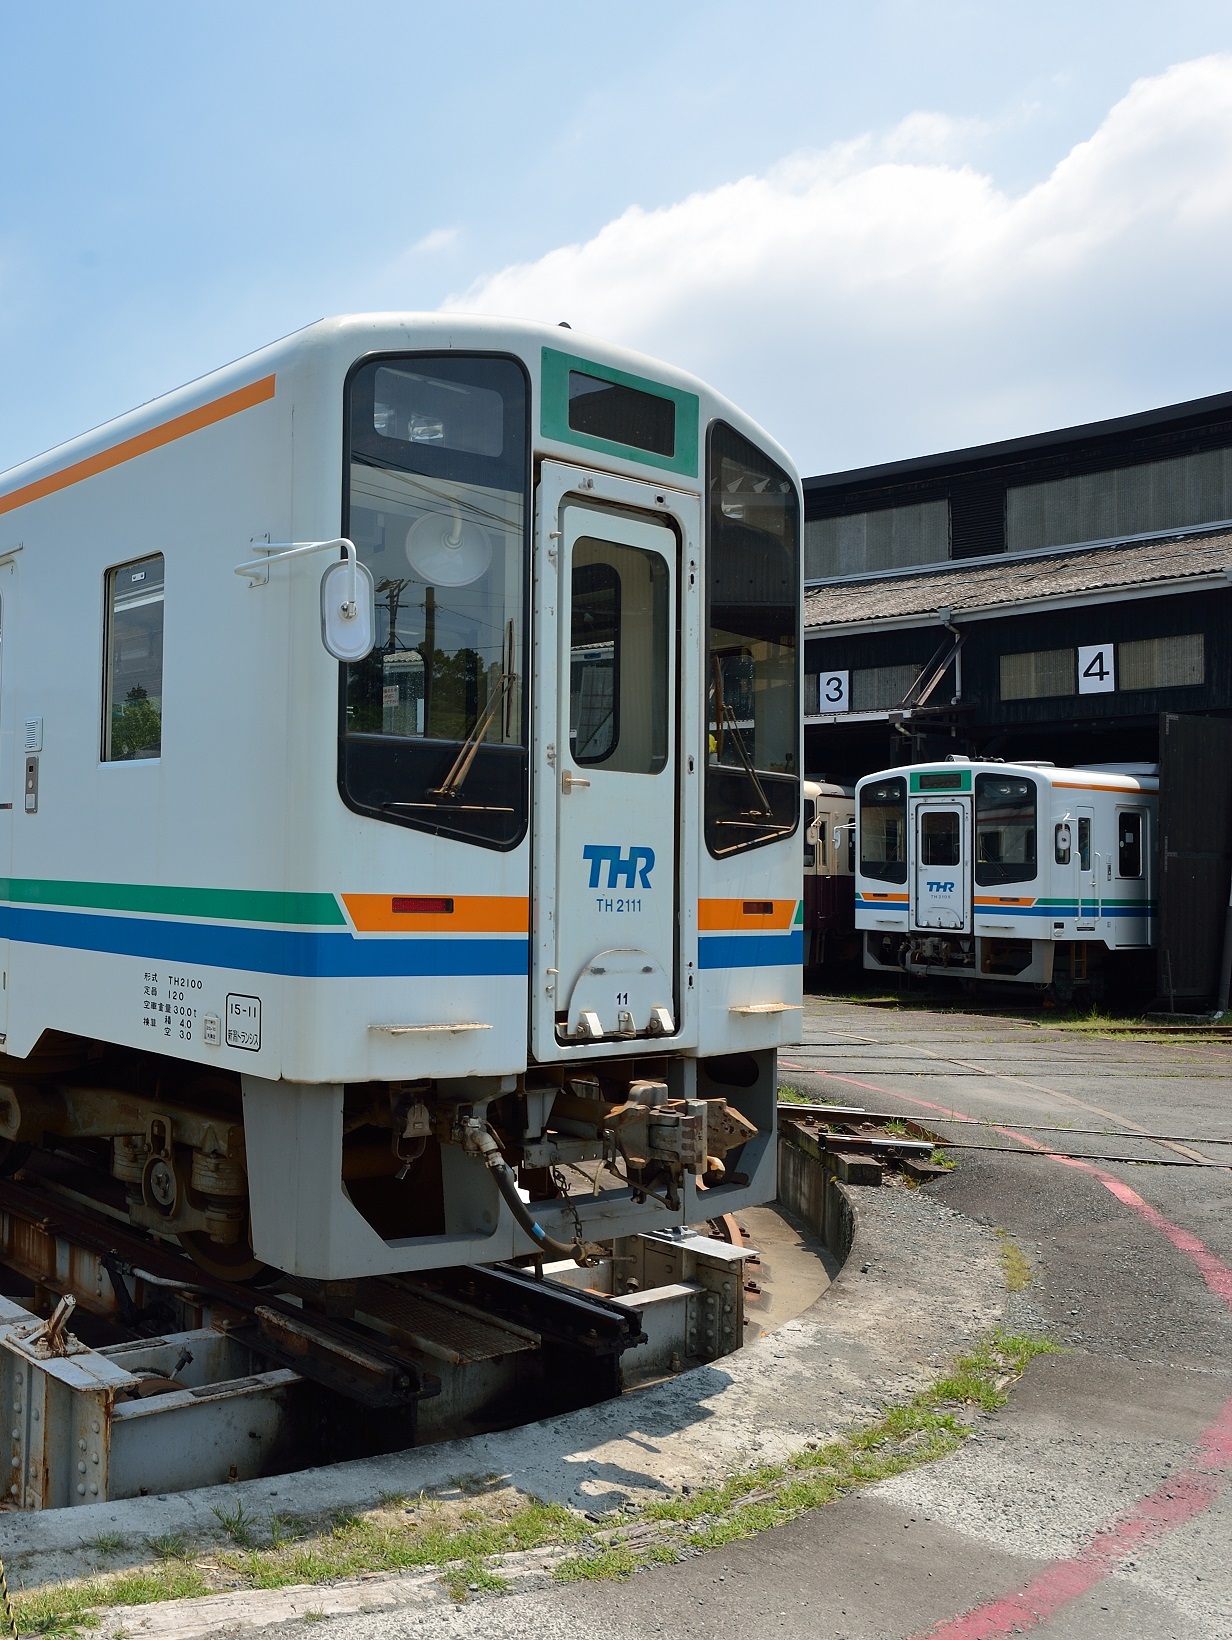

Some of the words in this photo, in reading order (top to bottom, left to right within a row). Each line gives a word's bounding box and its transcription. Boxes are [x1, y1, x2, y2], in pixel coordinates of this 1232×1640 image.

[1082, 651, 1110, 681] 4
[825, 676, 844, 703] 3
[582, 844, 656, 889] THR
[926, 882, 955, 892] THR
[143, 972, 158, 983] 形式
[168, 975, 203, 990] TH2100
[143, 985, 158, 997] 定員
[168, 990, 184, 1001] 120
[616, 992, 628, 1005] 11
[230, 1003, 257, 1018] 15-11
[179, 1019, 192, 1029] 4.0
[164, 1027, 171, 1037] 空
[179, 1030, 192, 1041] 3.0
[228, 1029, 259, 1046] 新潟トランシス
